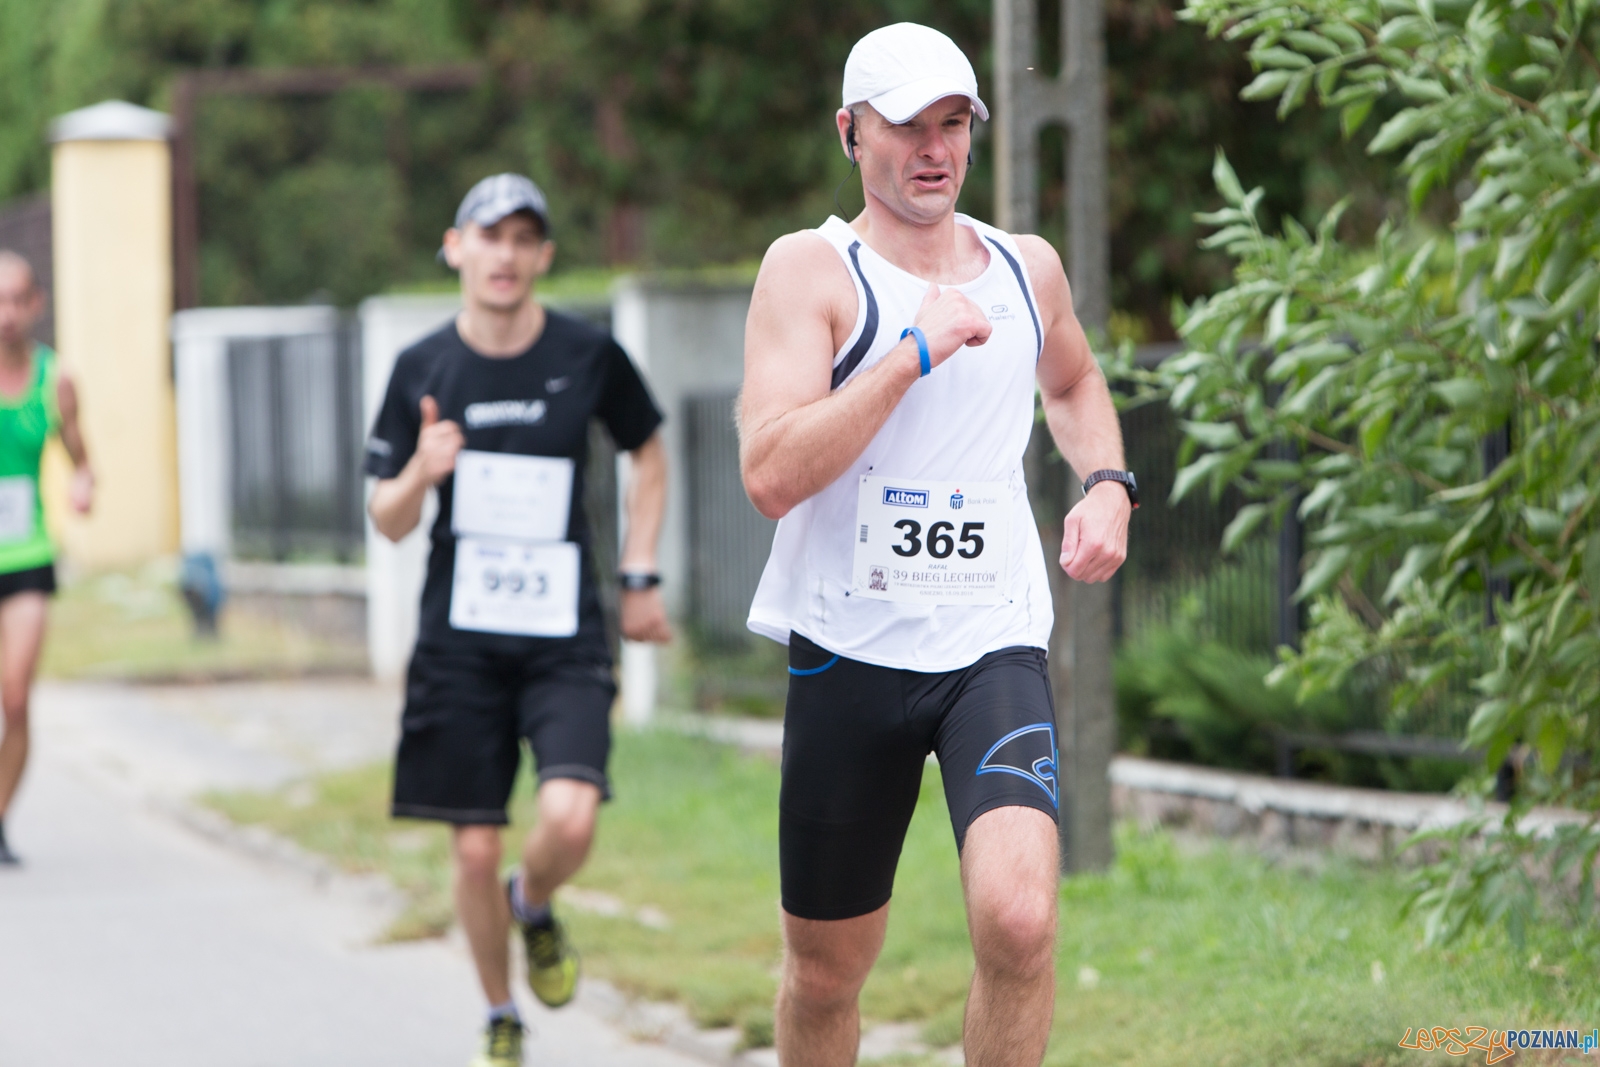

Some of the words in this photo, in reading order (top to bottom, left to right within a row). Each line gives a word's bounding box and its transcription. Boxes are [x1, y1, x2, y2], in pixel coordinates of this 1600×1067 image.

[891, 519, 985, 559] 365
[893, 569, 908, 581] 39
[912, 571, 940, 583] BIEG
[943, 570, 998, 583] LECHITÓW
